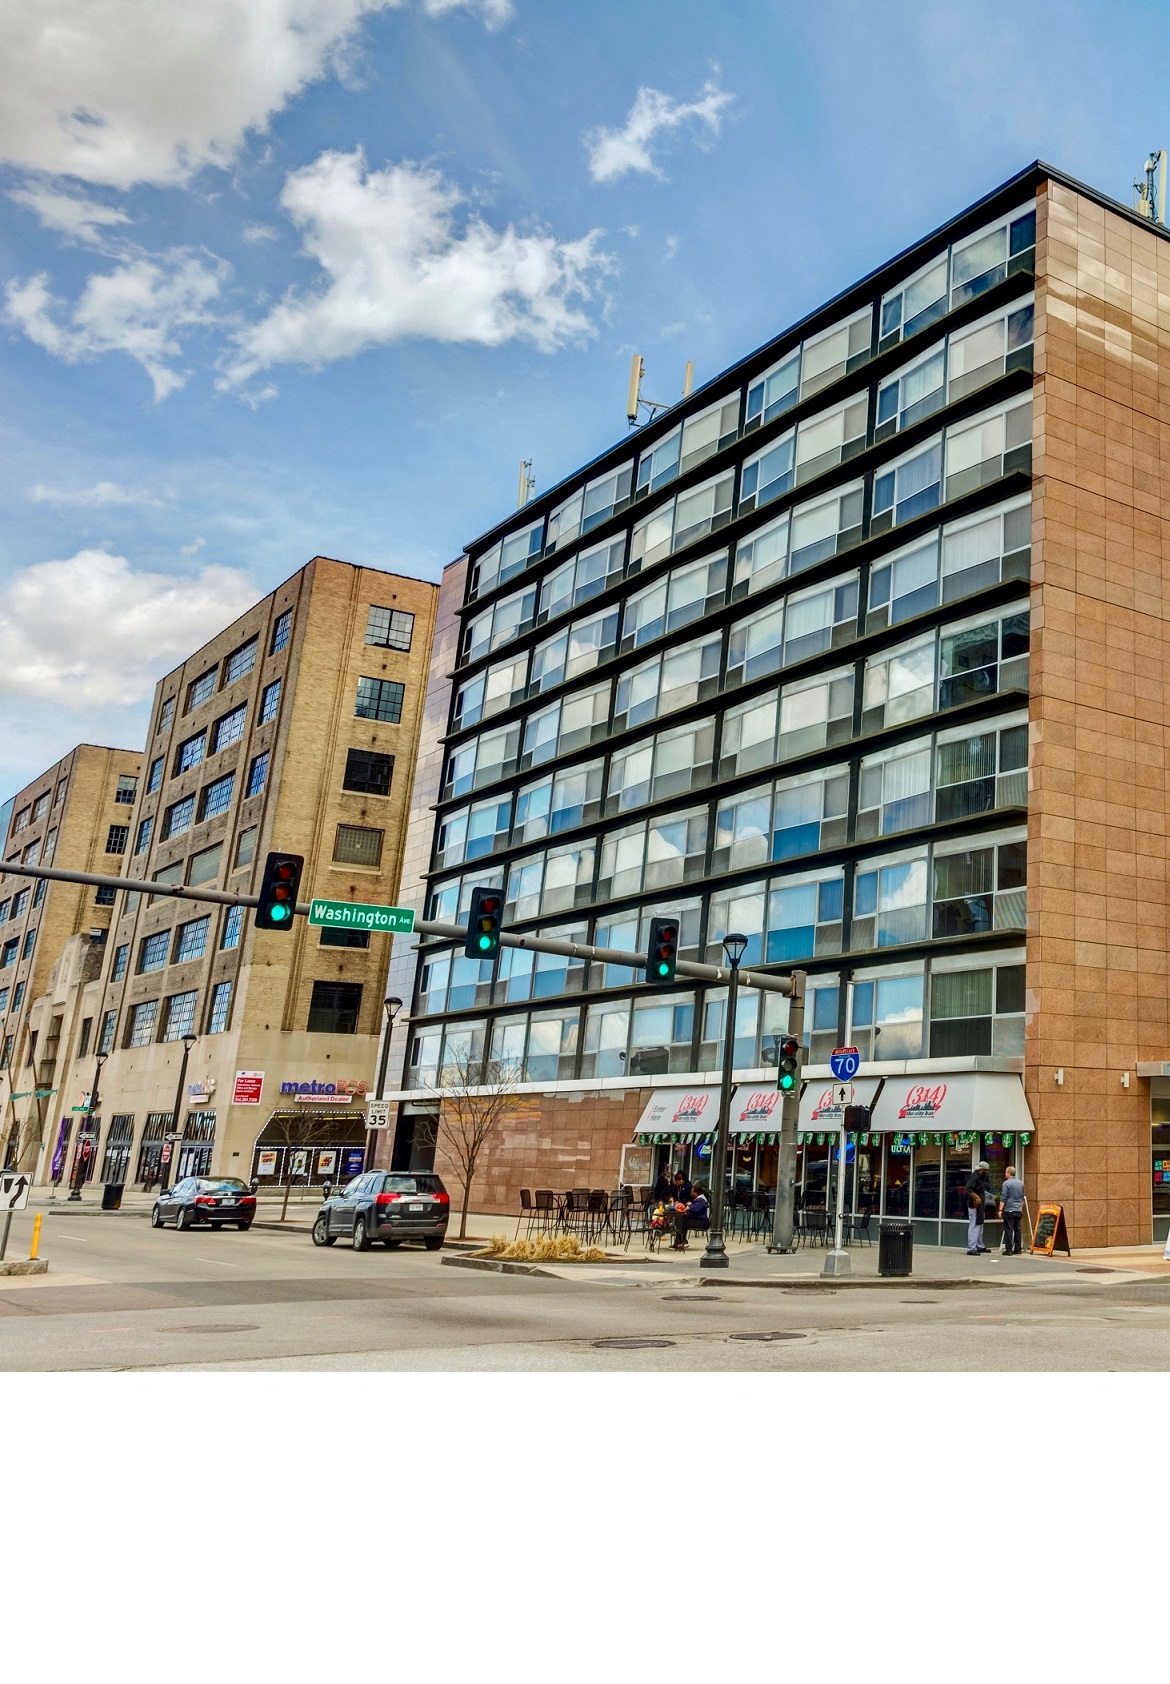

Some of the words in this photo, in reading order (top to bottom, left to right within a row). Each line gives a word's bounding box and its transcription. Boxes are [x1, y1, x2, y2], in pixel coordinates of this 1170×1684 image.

[314, 904, 397, 928] Washington
[834, 1057, 856, 1074] 70
[280, 1079, 368, 1096] metroPCS
[906, 1084, 947, 1107] (314)
[653, 1105, 667, 1113] Enter
[679, 1094, 709, 1112] (314)
[746, 1091, 780, 1110] (314)
[369, 1115, 387, 1126] 35
[891, 1144, 911, 1154] ULTRA
